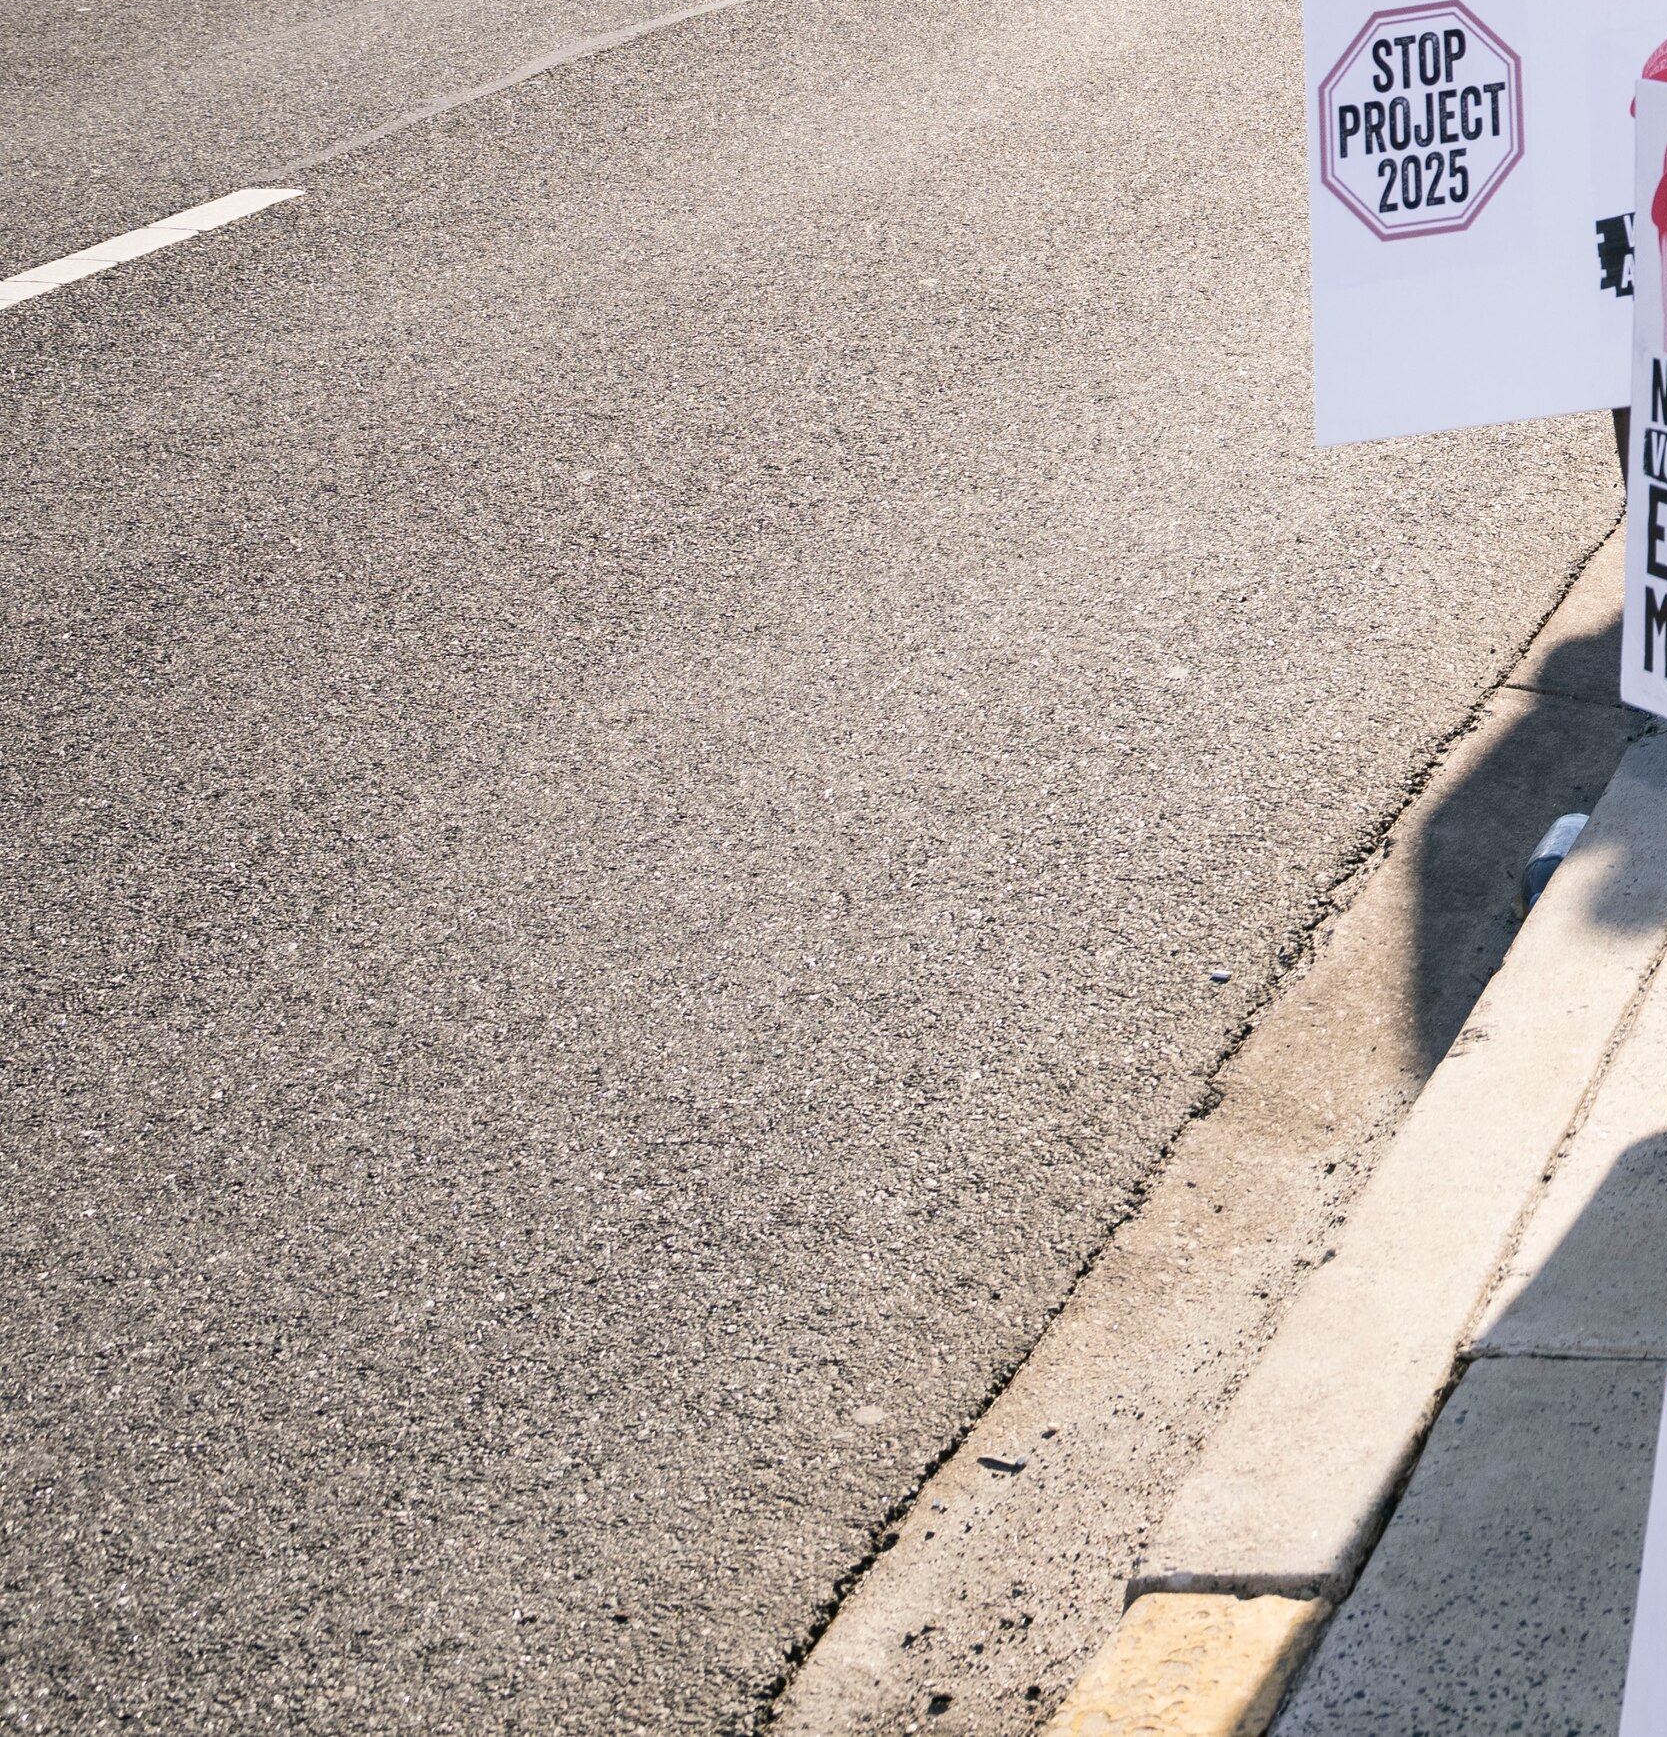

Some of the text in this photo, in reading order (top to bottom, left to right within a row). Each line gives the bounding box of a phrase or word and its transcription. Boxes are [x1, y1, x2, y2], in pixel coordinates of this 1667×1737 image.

[1371, 28, 1467, 94] STOP
[1338, 82, 1506, 159] PROJECT
[1378, 148, 1471, 214] 2025
